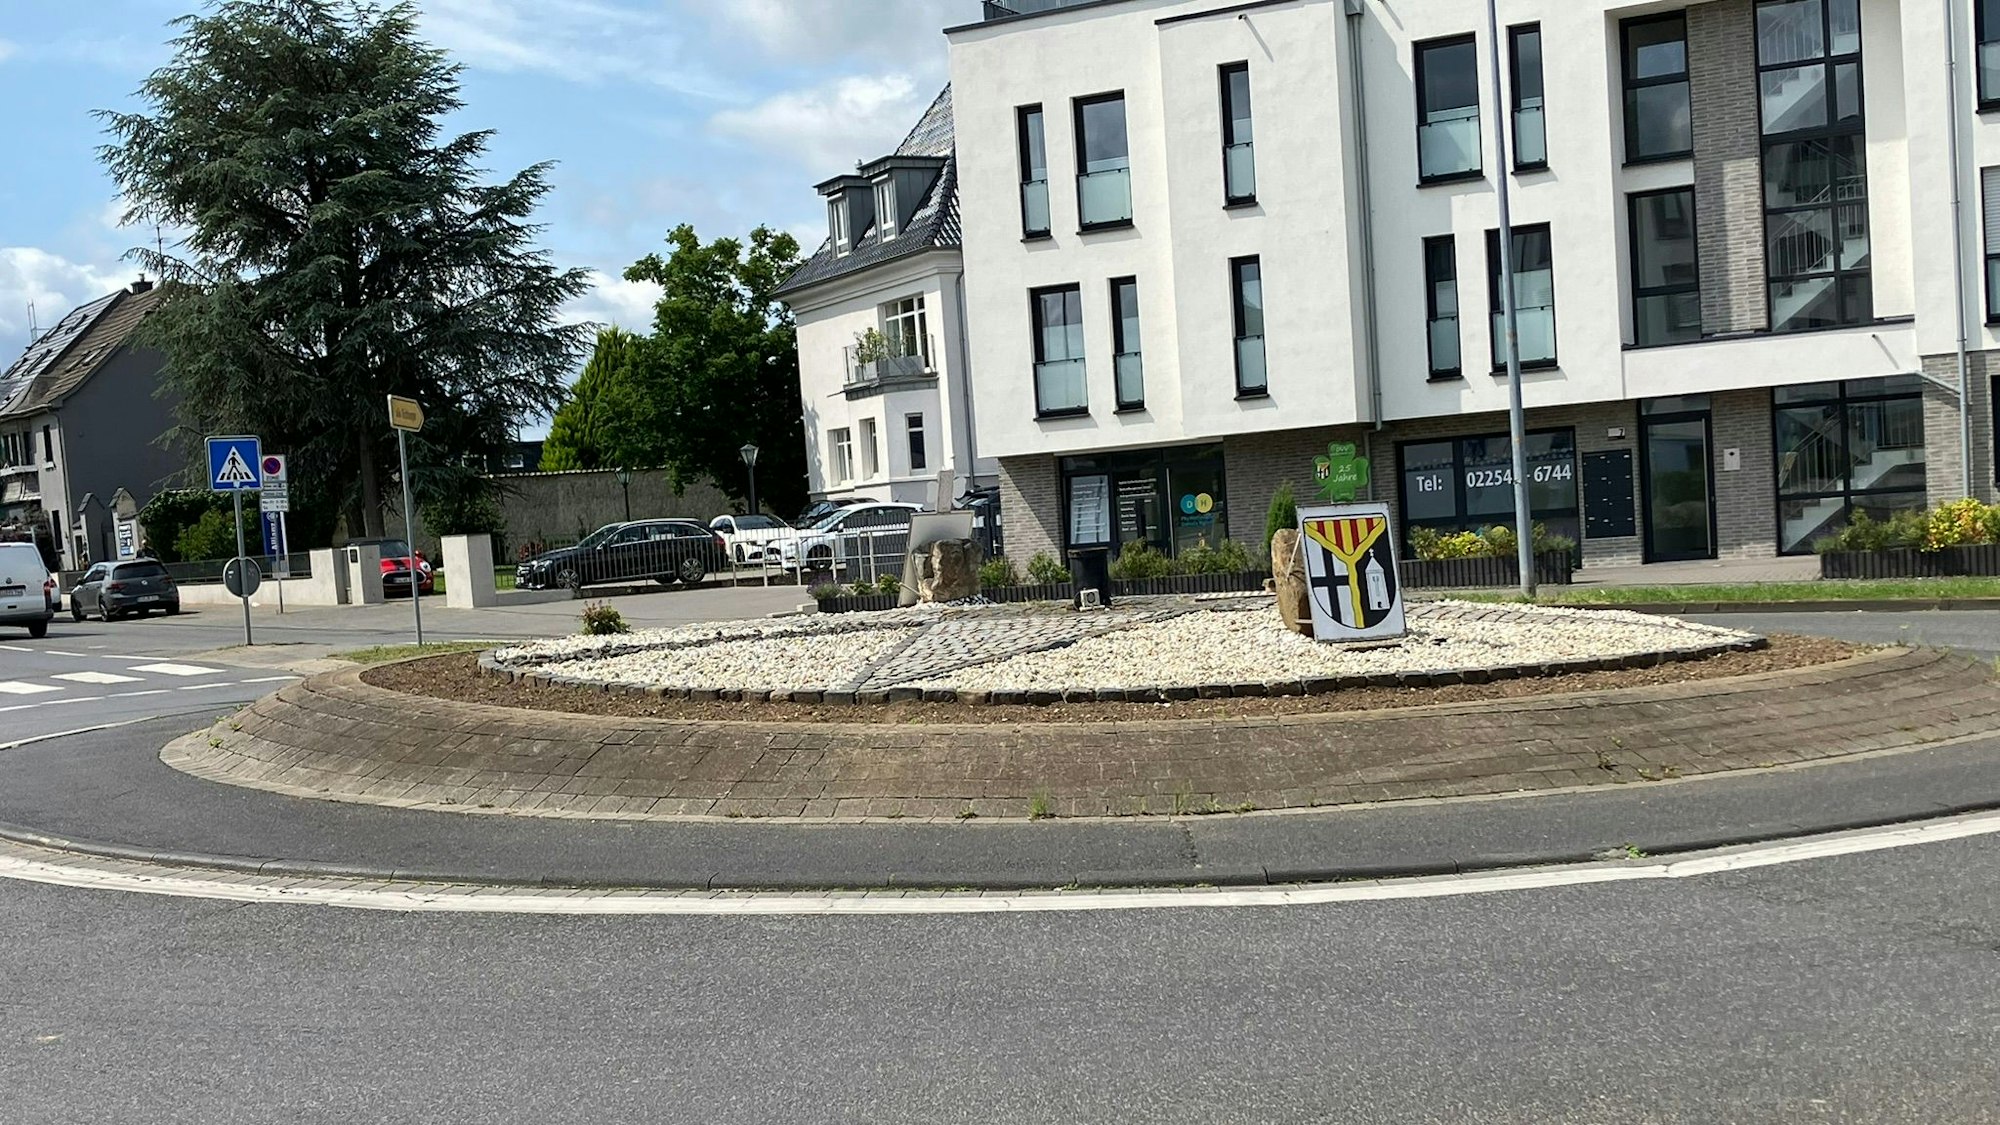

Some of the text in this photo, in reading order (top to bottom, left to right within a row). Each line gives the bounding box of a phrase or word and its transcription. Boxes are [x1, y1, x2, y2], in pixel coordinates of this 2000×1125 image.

[1619, 428, 1624, 436] 7
[1339, 464, 1352, 473] 25
[1332, 473, 1358, 483] Jahre
[1416, 475, 1443, 492] Tel:
[1466, 469, 1512, 487] 02254
[1533, 464, 1572, 482] 6744
[1200, 499, 1207, 507] H
